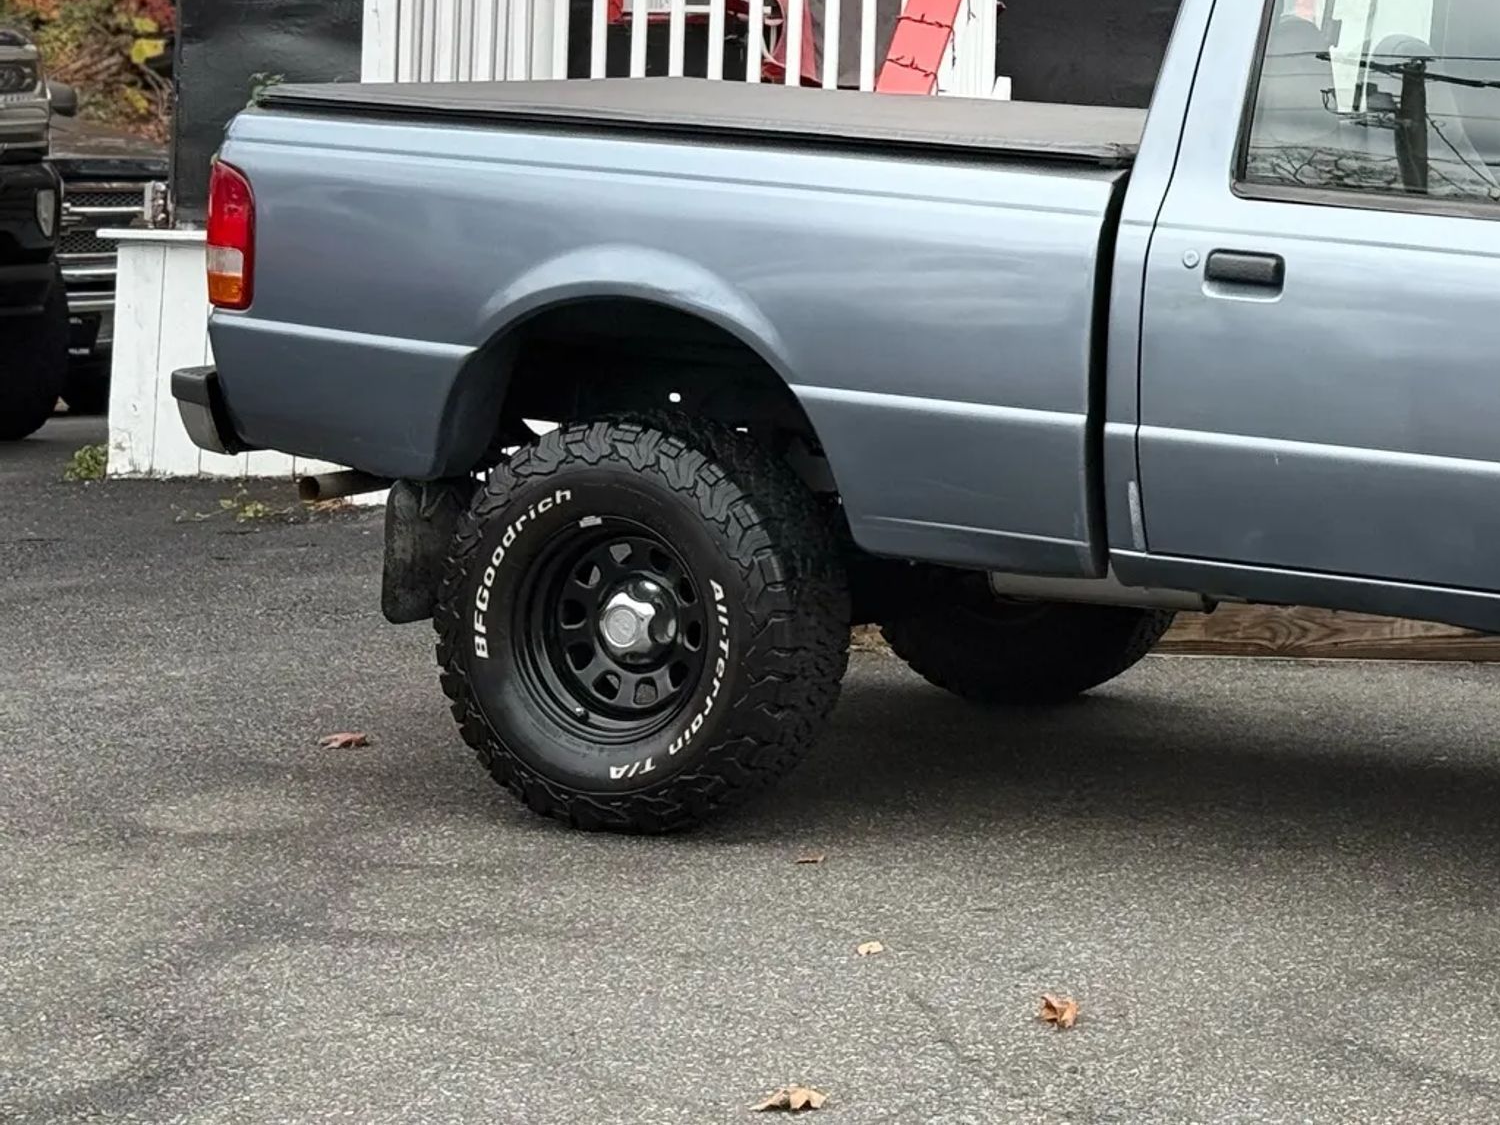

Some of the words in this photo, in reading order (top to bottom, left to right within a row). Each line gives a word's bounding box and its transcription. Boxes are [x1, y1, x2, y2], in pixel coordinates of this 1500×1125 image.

[473, 489, 571, 658] BFGoodrich
[668, 579, 730, 756] All-Terrain
[609, 756, 656, 780] T/A
